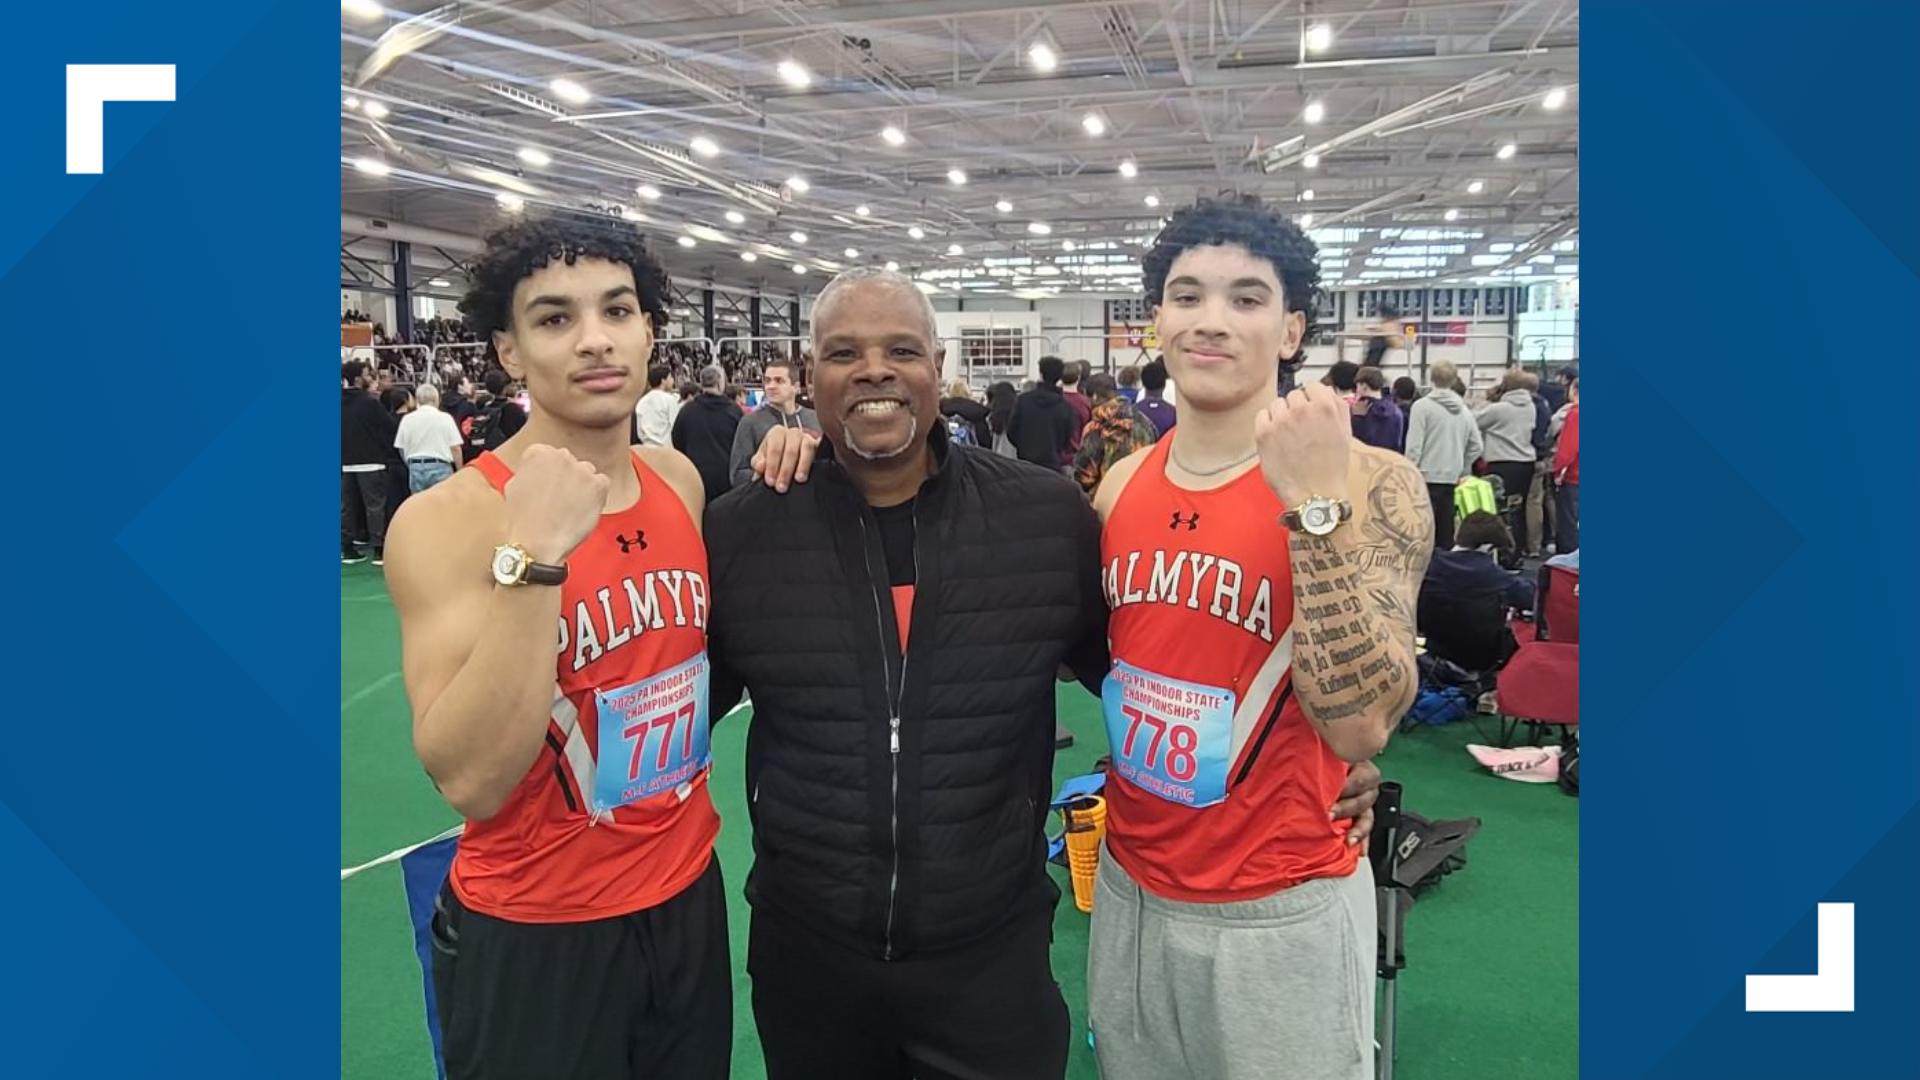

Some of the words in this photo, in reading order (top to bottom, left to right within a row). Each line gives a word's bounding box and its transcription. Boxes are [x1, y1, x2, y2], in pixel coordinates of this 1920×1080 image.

[1101, 550, 1275, 644] ALMYRA
[612, 694, 636, 713] 2025
[637, 688, 649, 701] PA
[651, 675, 684, 697] INDOOR
[684, 662, 704, 681] STATE
[625, 682, 694, 721] CHAMPIONSHIPS
[1111, 669, 1132, 685] 2025
[1134, 675, 1145, 688] PA
[1147, 679, 1182, 701] INDOOR
[1186, 690, 1222, 709] STATE
[1123, 686, 1201, 721] CHAMPIONSHIPS
[623, 701, 696, 782] 777
[1121, 703, 1198, 782] 778
